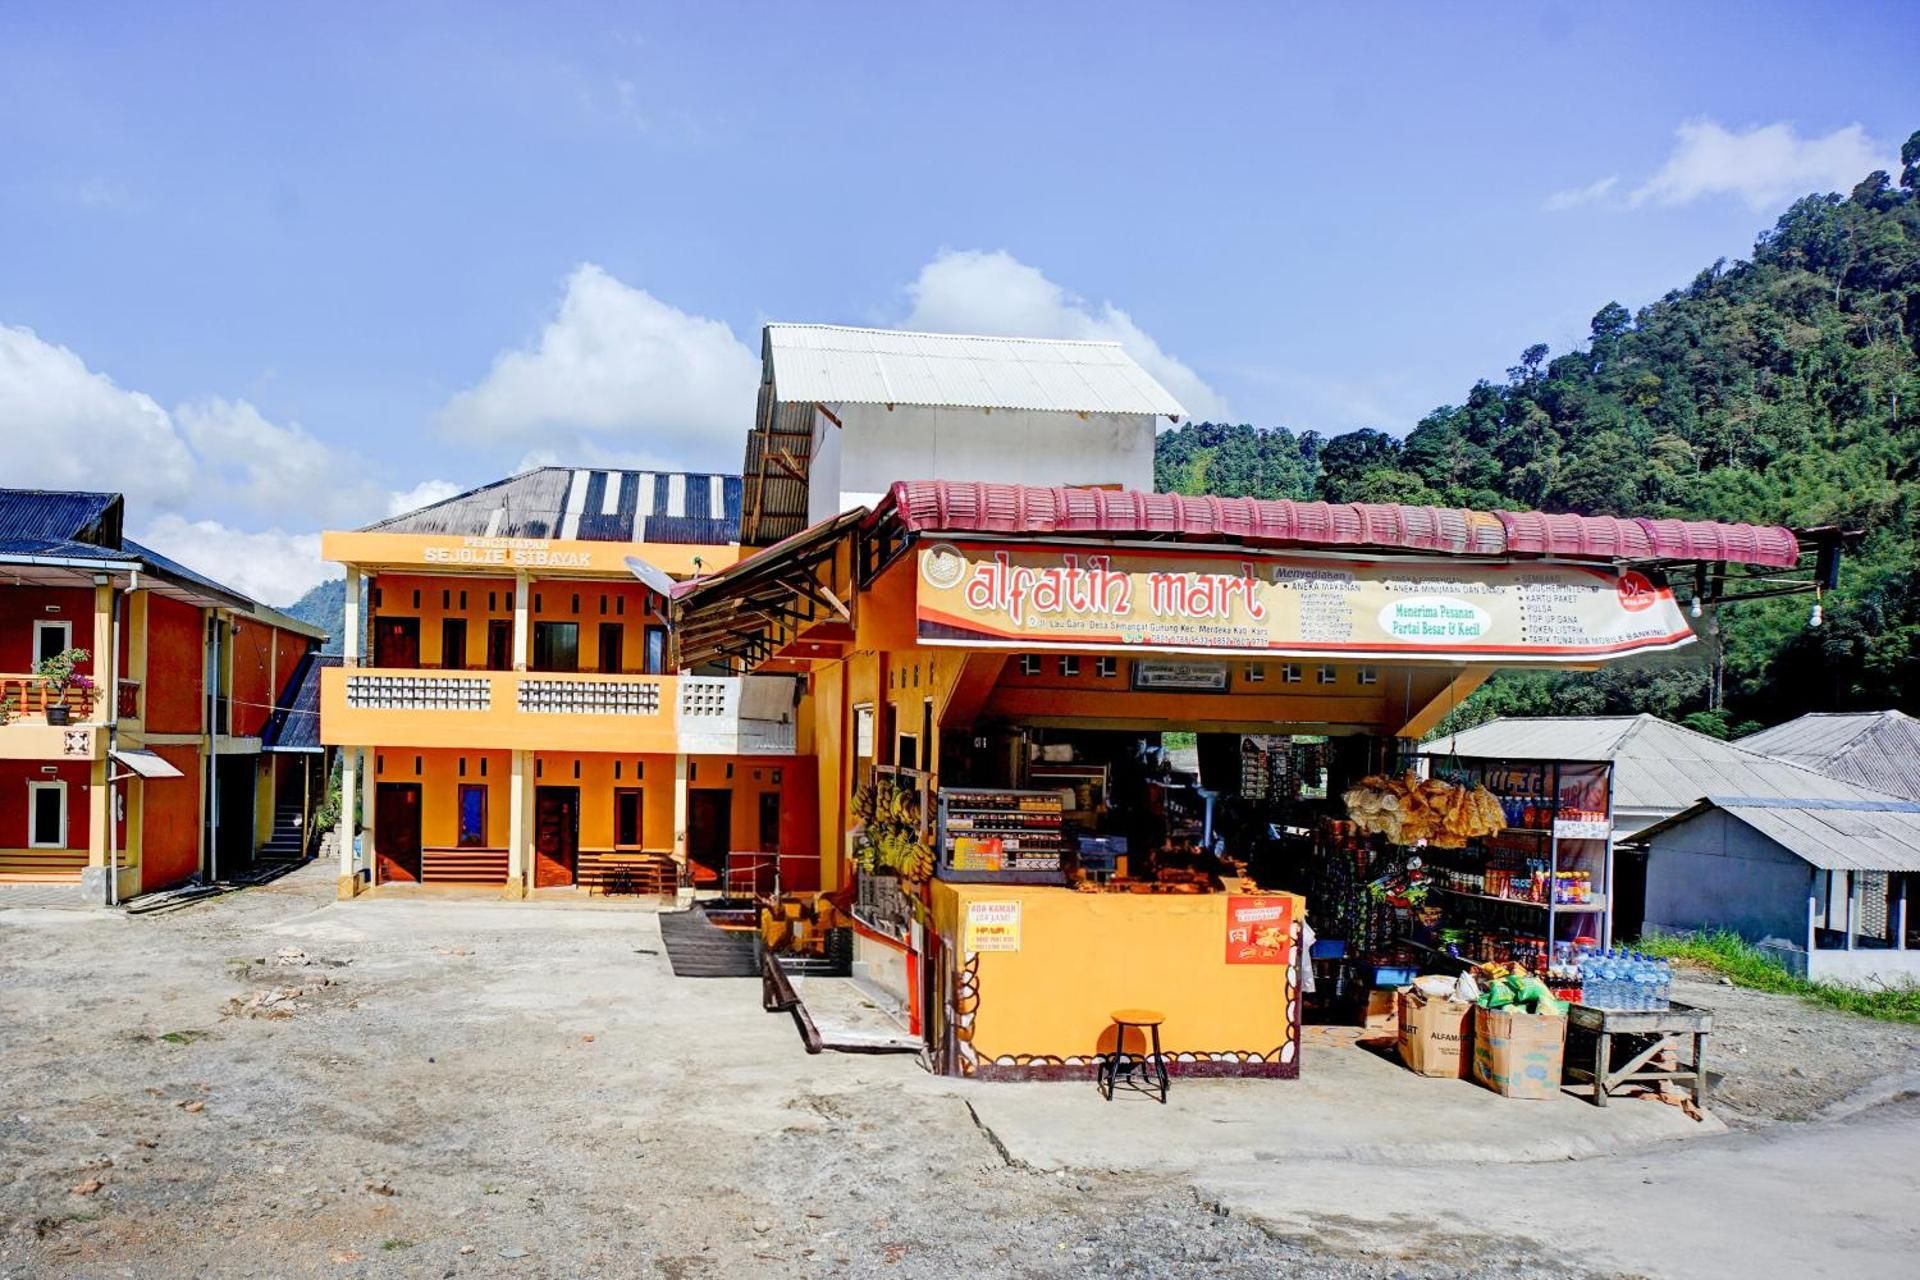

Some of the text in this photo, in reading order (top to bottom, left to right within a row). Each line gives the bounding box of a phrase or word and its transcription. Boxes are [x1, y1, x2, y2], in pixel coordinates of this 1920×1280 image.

[424, 547, 591, 567] SEJOLIE SIBAYAK
[965, 551, 1265, 624] alfatih mart
[1291, 582, 1319, 591] ANEKA
[1393, 586, 1419, 594] ANEKA
[1463, 586, 1480, 594] DAN
[1553, 594, 1578, 604] PAKET
[1395, 603, 1475, 619] Menerima Pesanan
[1527, 604, 1552, 614] PULSA
[1528, 613, 1578, 624] TOP UP DANA
[1089, 620, 1108, 630] Desa
[1110, 621, 1148, 632] Semangat
[1150, 623, 1179, 634] Gunung
[1198, 625, 1232, 635] Merdeka
[1391, 620, 1481, 637] Partai Besar & Kecil
[1552, 635, 1576, 645] TUNAI
